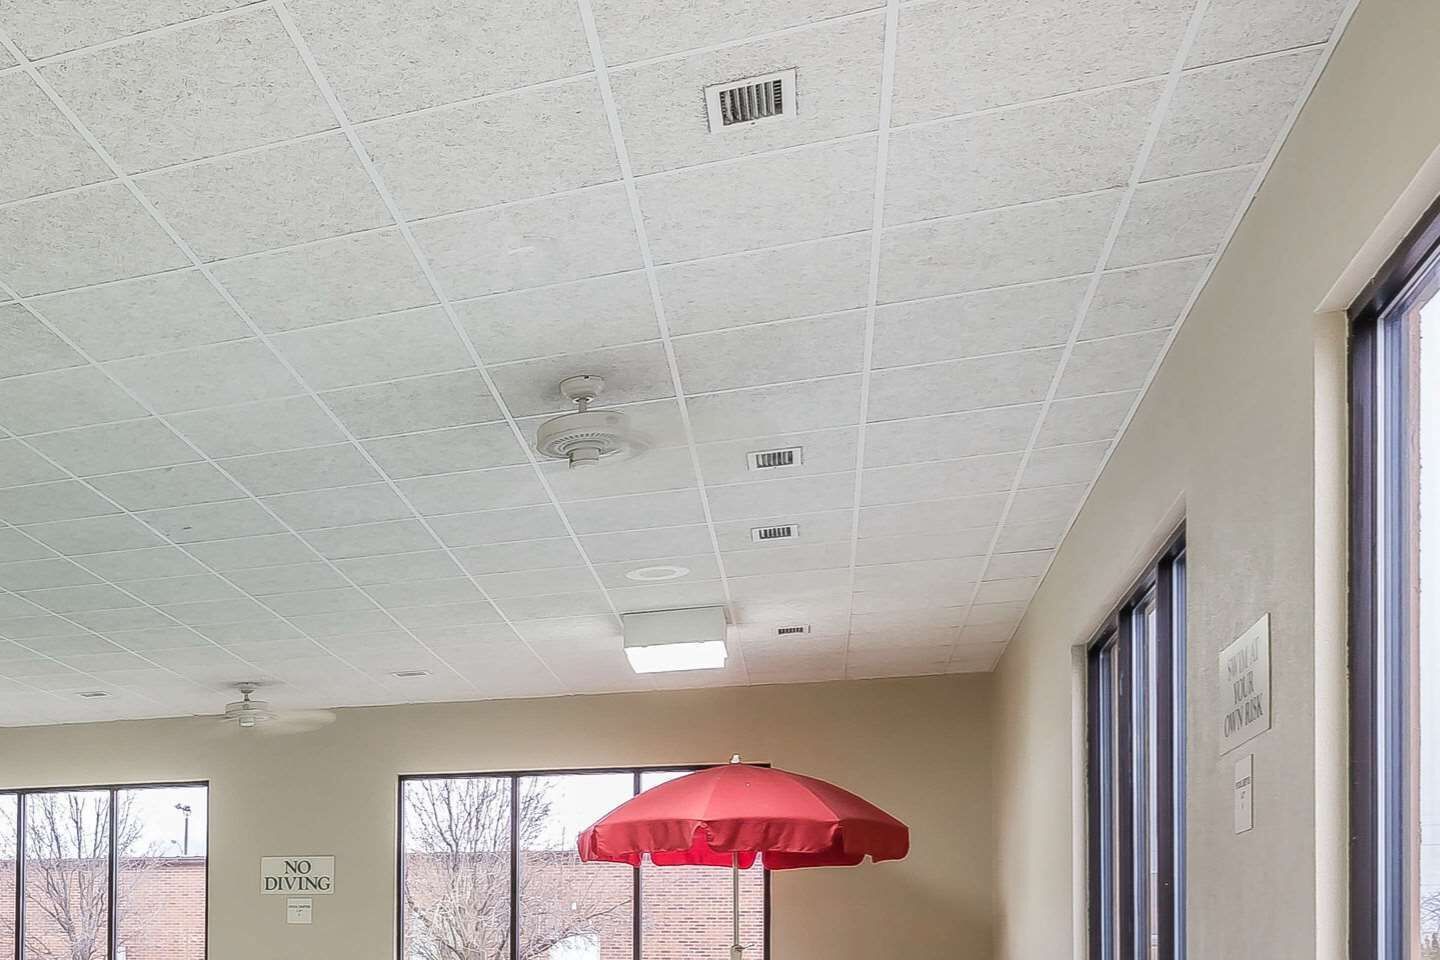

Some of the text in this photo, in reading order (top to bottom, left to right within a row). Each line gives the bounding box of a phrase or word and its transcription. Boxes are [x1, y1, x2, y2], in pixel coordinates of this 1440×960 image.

[1233, 671, 1254, 705] YOUR
[1224, 693, 1263, 737] OWN RISK
[284, 860, 312, 875] NO
[264, 876, 331, 891] DIVING
